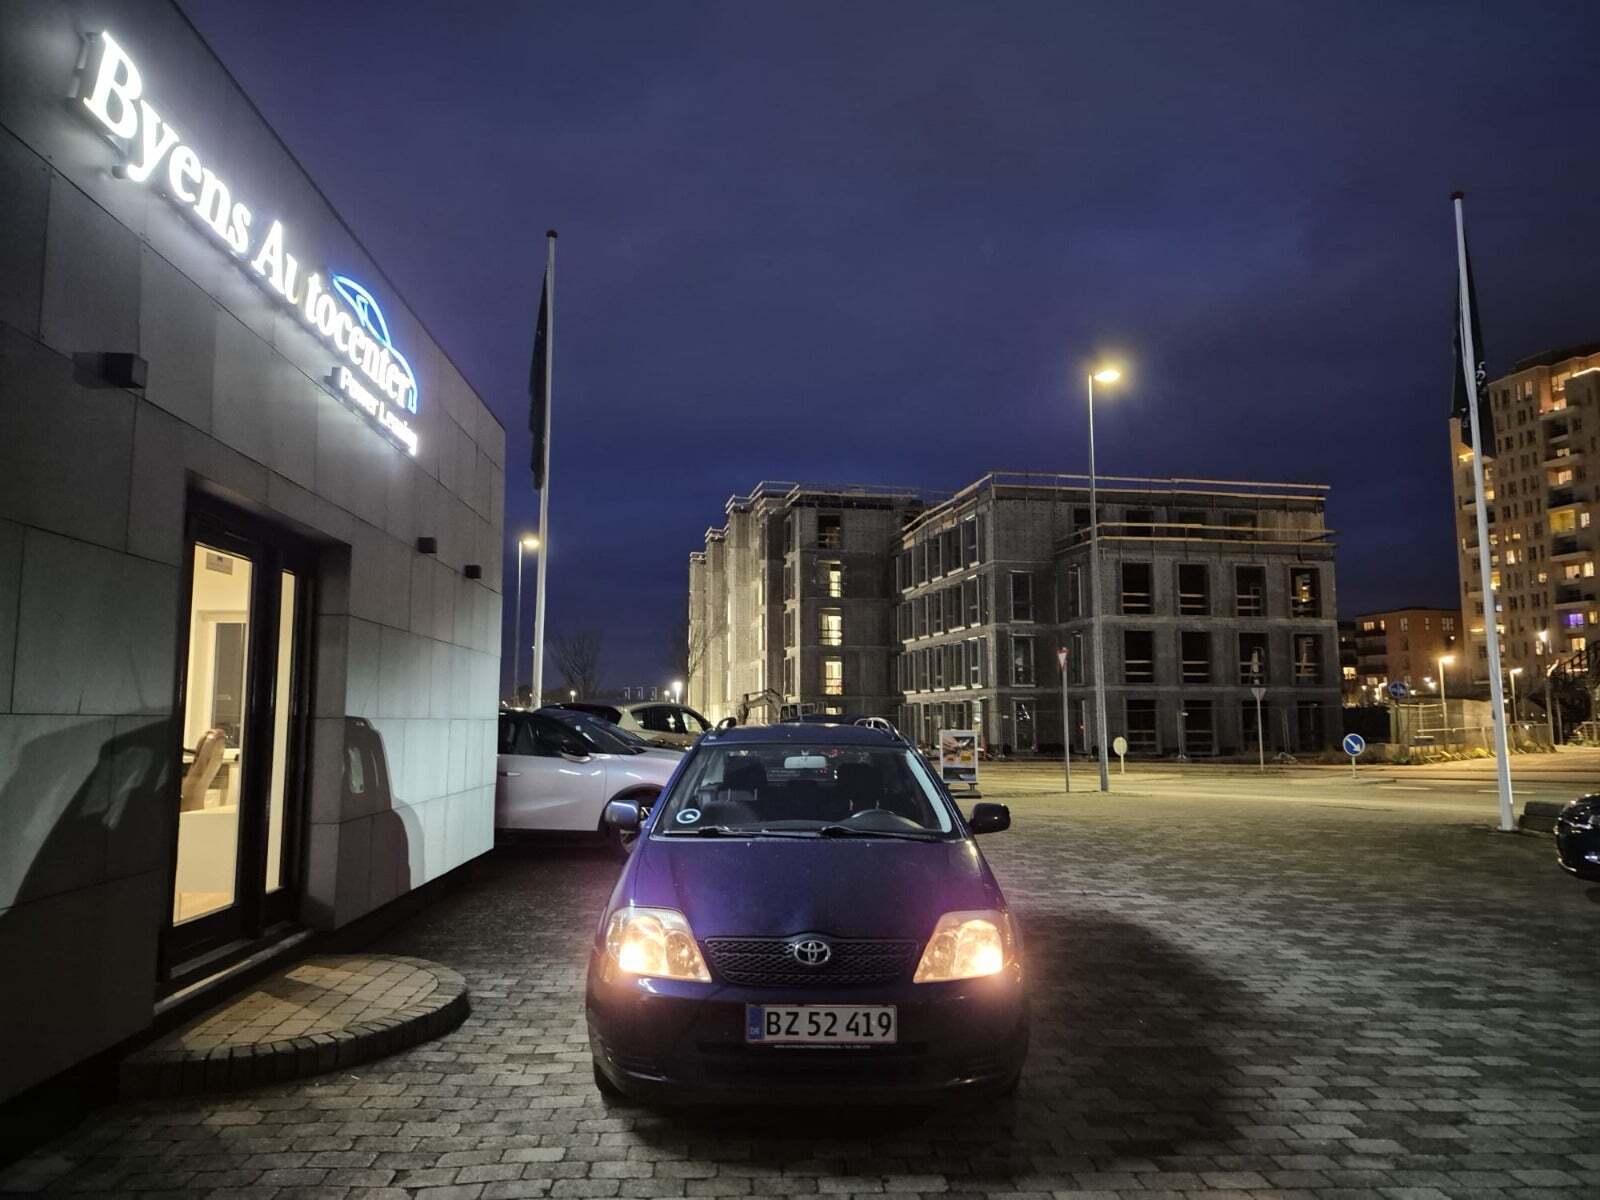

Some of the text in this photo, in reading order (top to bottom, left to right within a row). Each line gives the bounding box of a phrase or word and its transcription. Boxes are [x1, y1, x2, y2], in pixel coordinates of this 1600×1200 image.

[83, 30, 410, 409] Byens Autocenter
[766, 1011, 892, 1037] BZ 52 419
